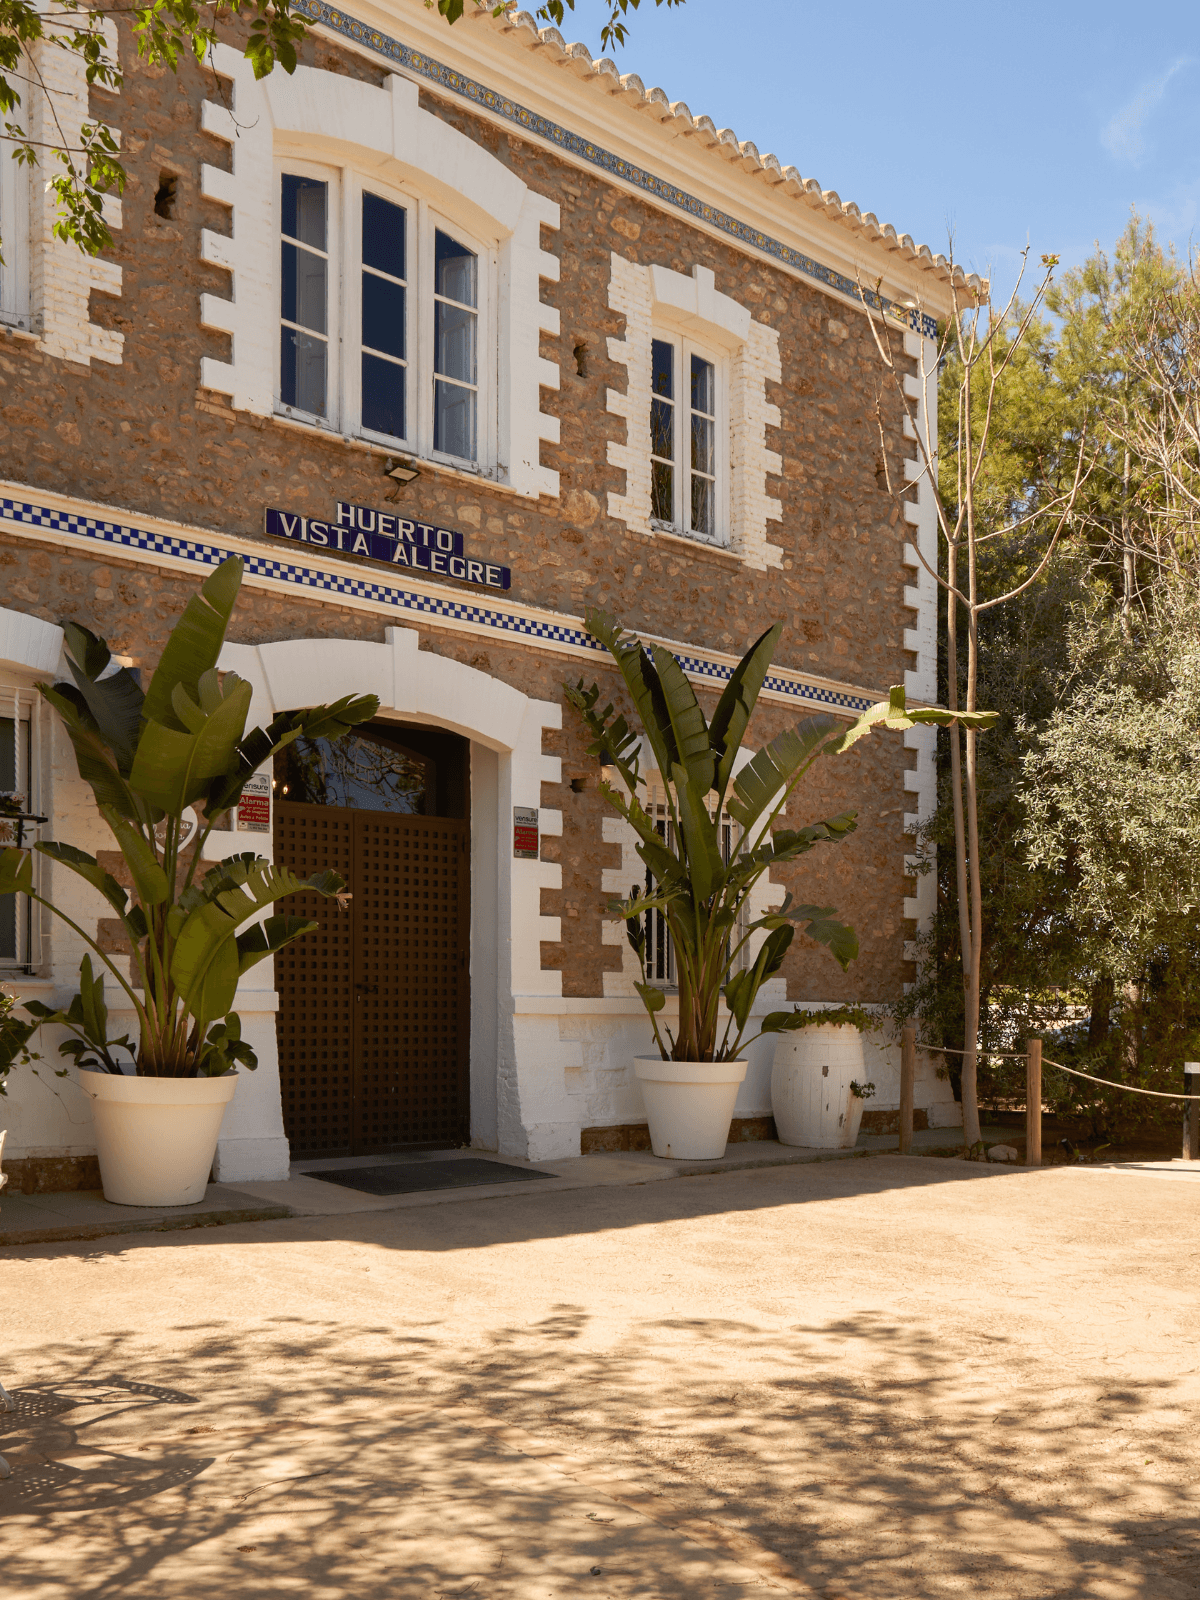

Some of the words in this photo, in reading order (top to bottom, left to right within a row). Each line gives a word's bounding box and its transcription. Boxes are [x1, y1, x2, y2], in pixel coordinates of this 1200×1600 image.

[279, 512, 370, 555] VISTA
[392, 542, 502, 587] ALEGRE
[337, 502, 453, 551] HUERTO
[240, 797, 268, 806] Alarma
